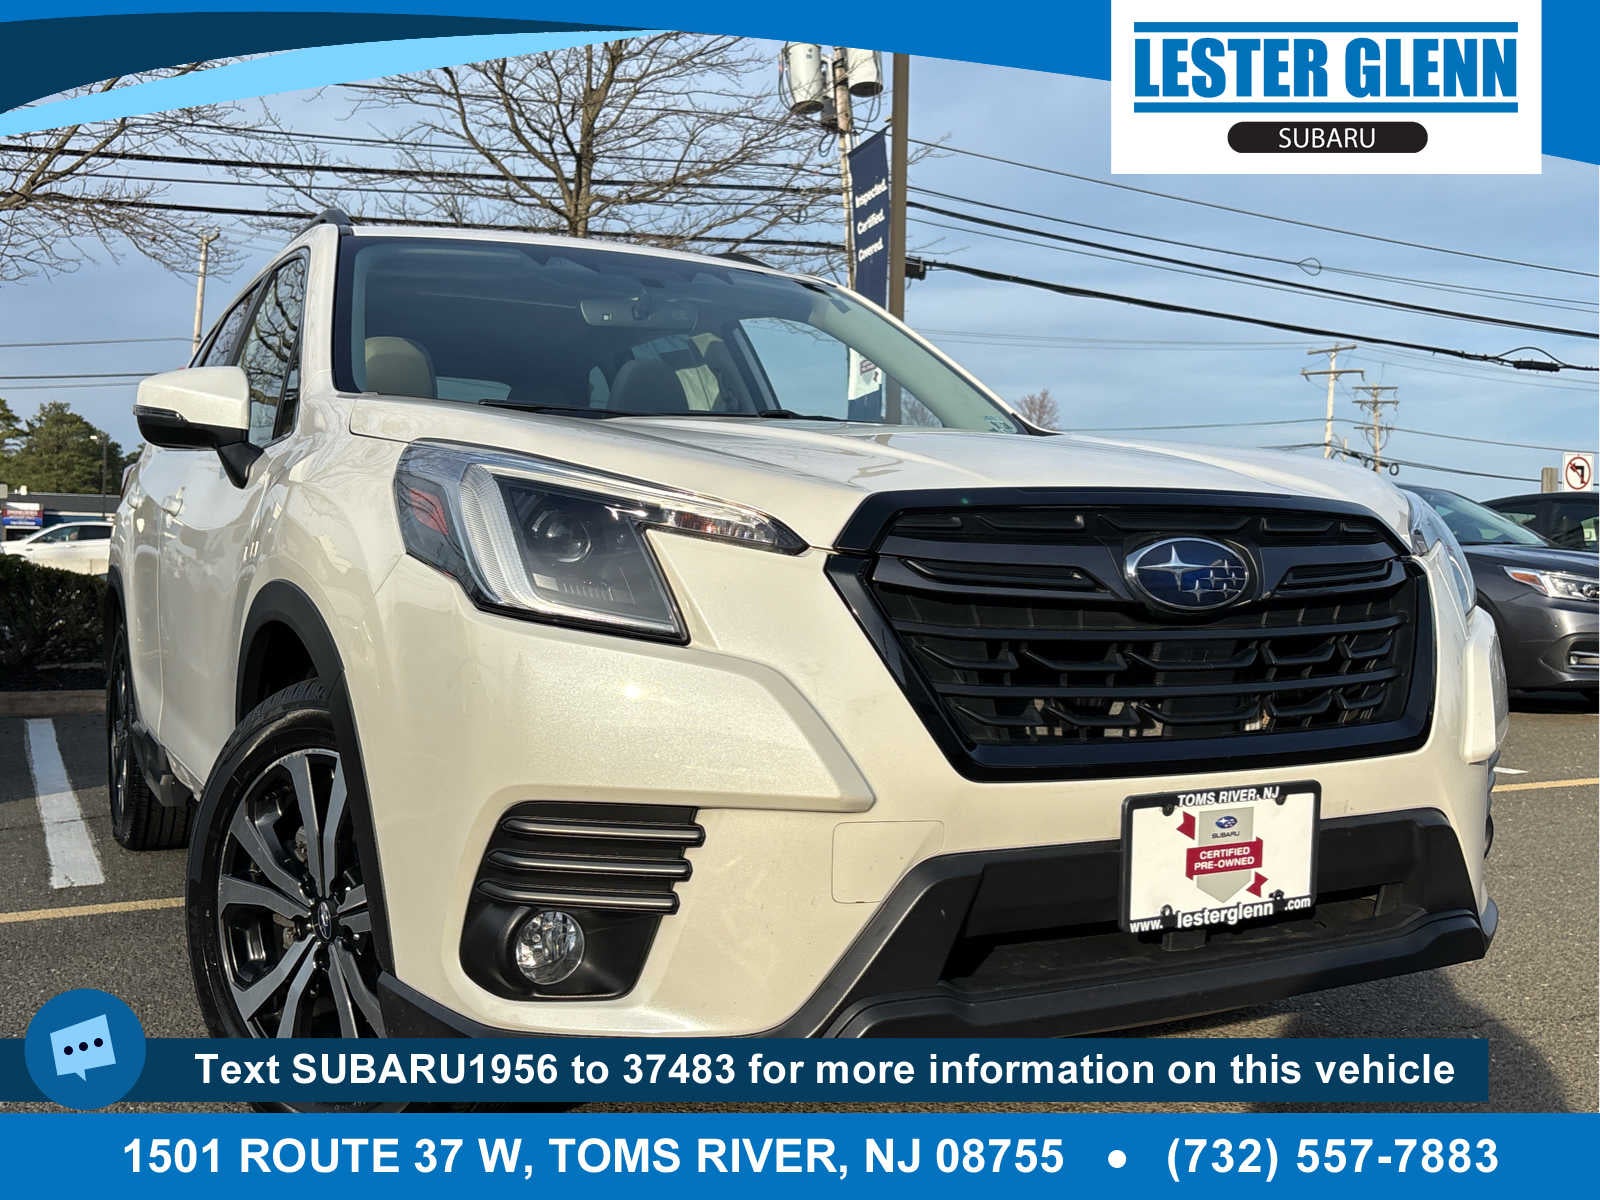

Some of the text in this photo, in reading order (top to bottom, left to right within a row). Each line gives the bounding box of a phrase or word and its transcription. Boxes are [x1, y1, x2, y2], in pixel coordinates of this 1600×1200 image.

[1177, 786, 1280, 807] TOMS RIVER, NJ
[1211, 831, 1240, 839] SUBARU
[1199, 846, 1251, 860] CERTIFIED
[1193, 856, 1255, 871] PRE-OWNED
